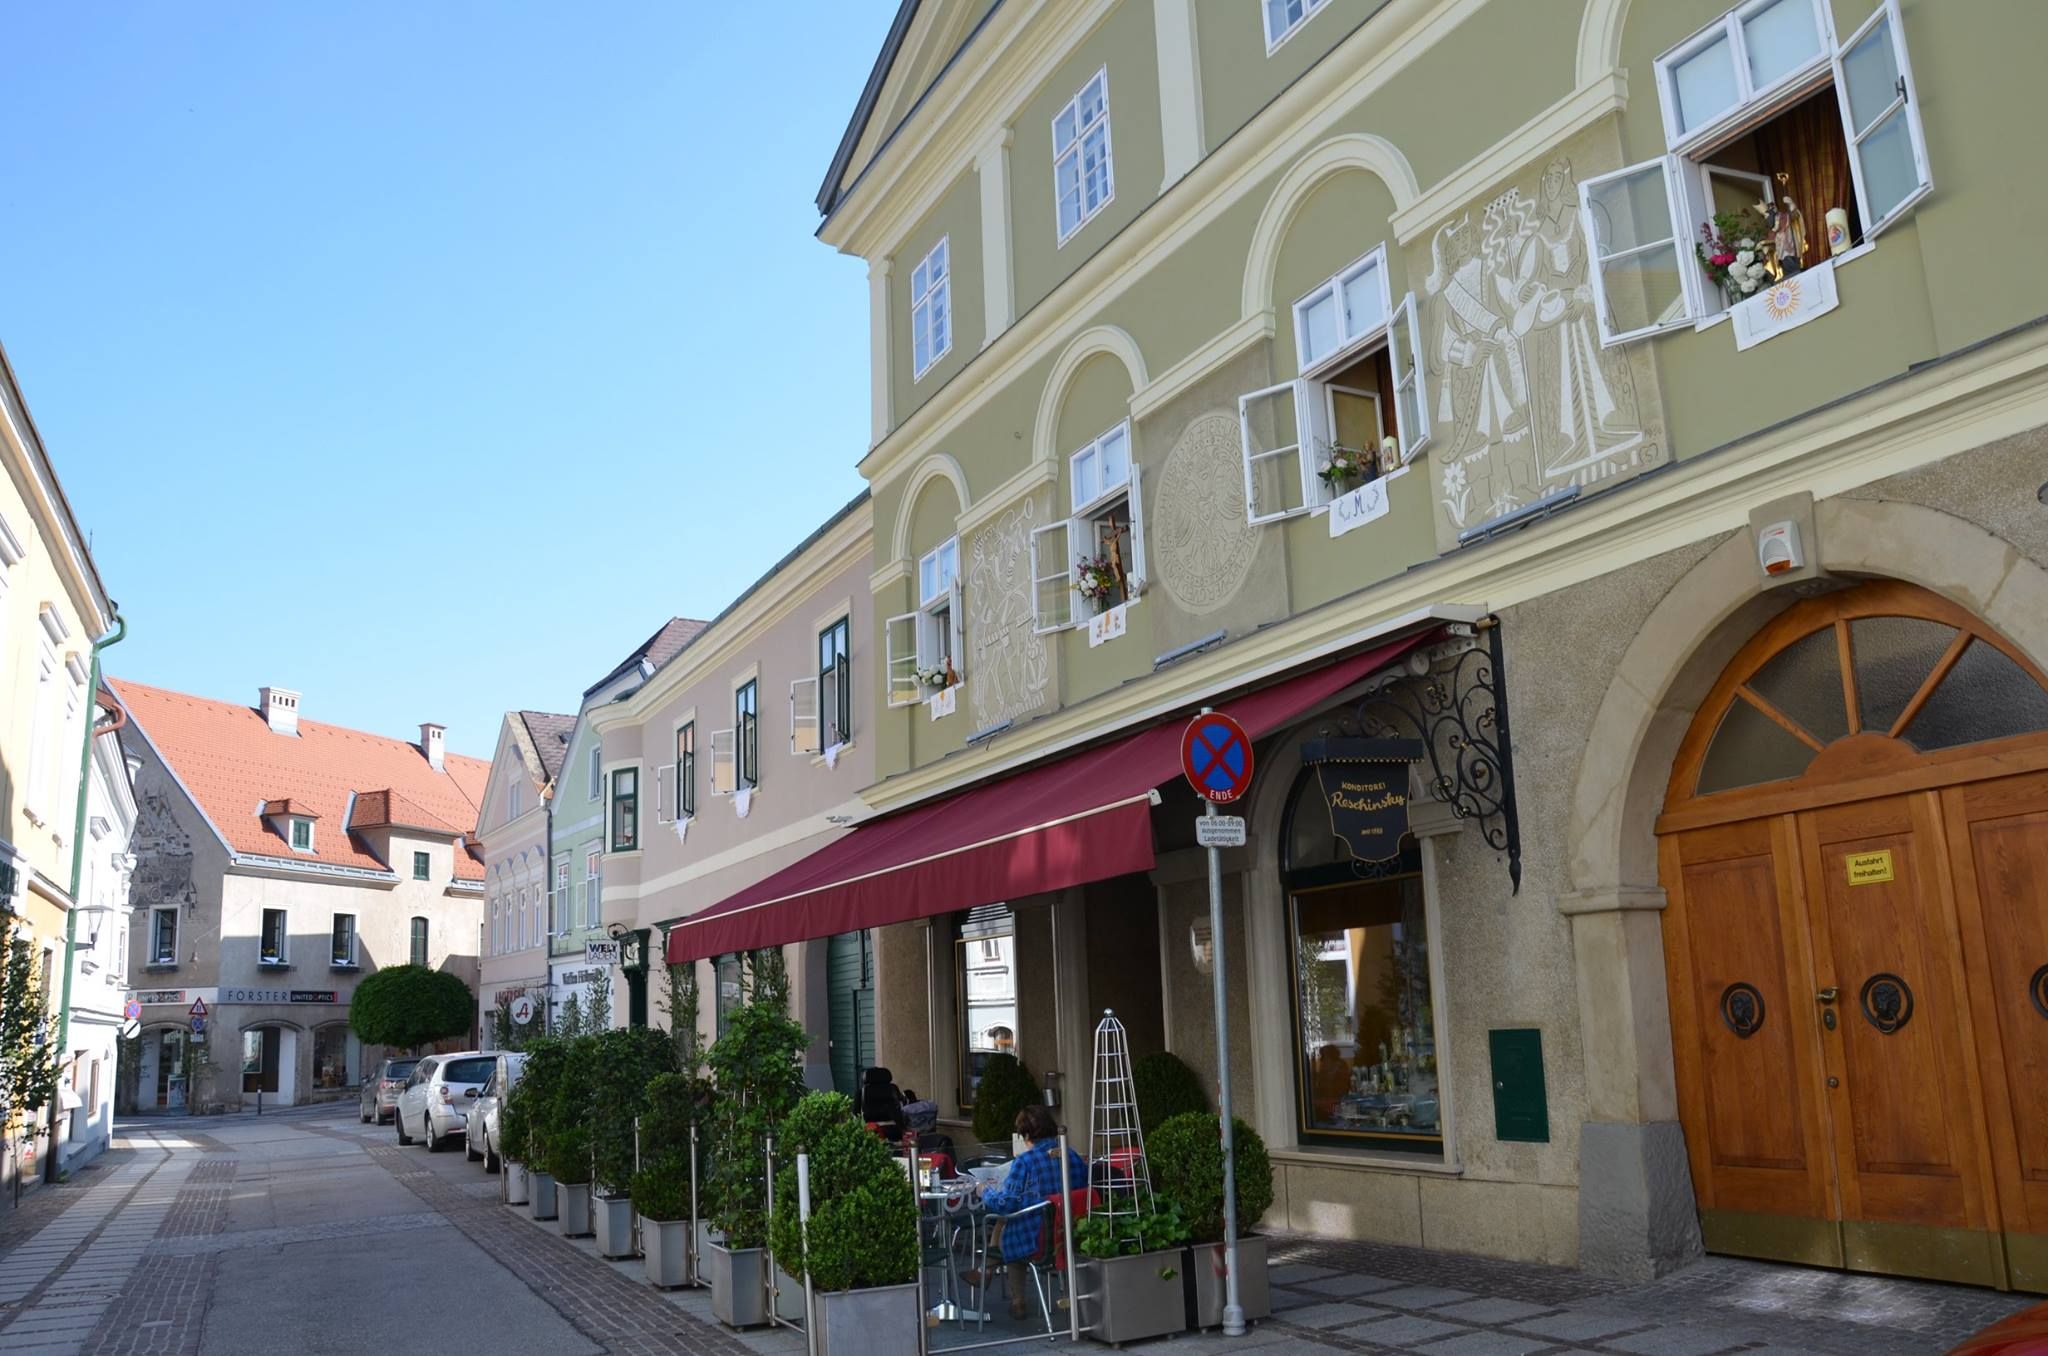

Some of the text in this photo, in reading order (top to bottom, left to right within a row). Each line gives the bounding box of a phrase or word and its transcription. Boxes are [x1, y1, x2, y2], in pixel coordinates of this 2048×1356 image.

[1342, 782, 1386, 791] KONDITOREI
[1210, 789, 1233, 800] ENDE
[1855, 857, 1884, 867] Ausfahrt
[589, 943, 618, 953] WELT
[589, 952, 617, 960] LADEN
